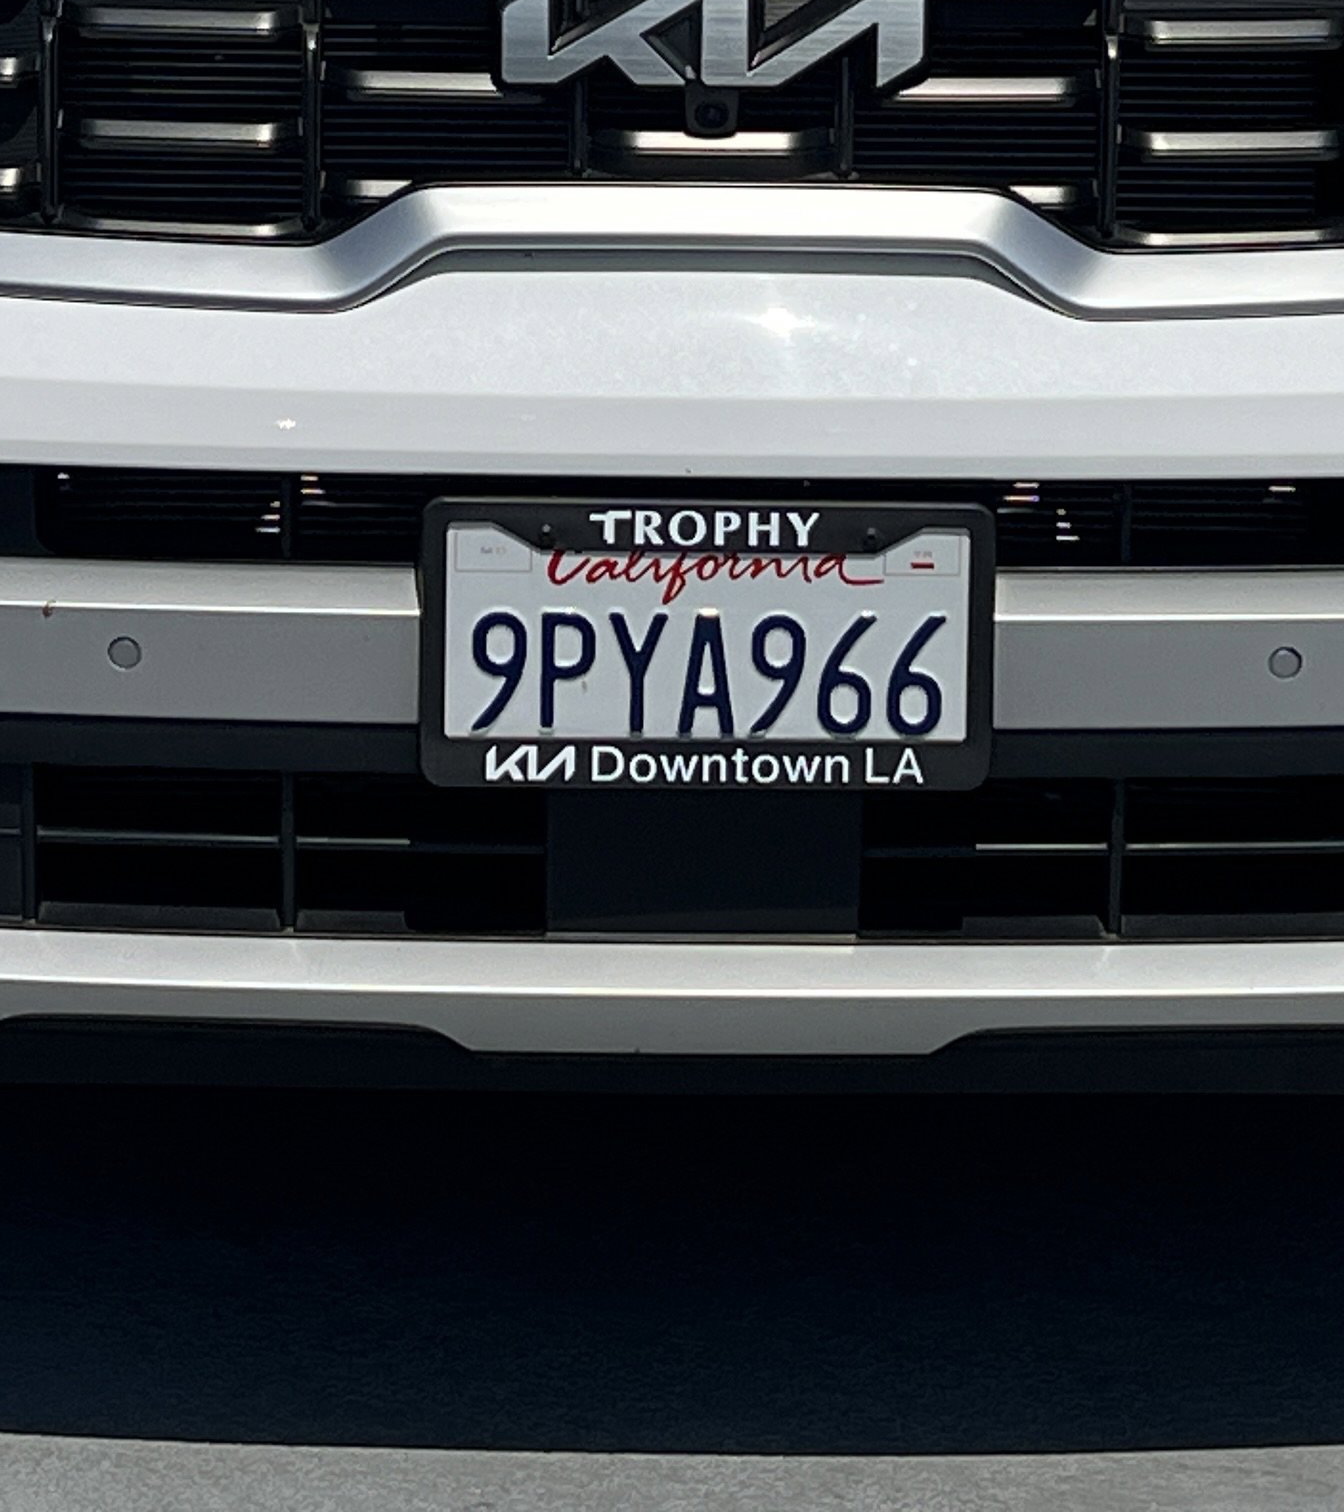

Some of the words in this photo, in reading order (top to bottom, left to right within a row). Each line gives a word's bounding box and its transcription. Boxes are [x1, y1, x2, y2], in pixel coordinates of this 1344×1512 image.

[589, 509, 820, 546] TROPHY
[547, 549, 884, 605] California
[471, 611, 947, 736] 9PYA966
[485, 745, 575, 782] KIA
[591, 745, 851, 784] Downtown
[864, 746, 924, 784] LA
